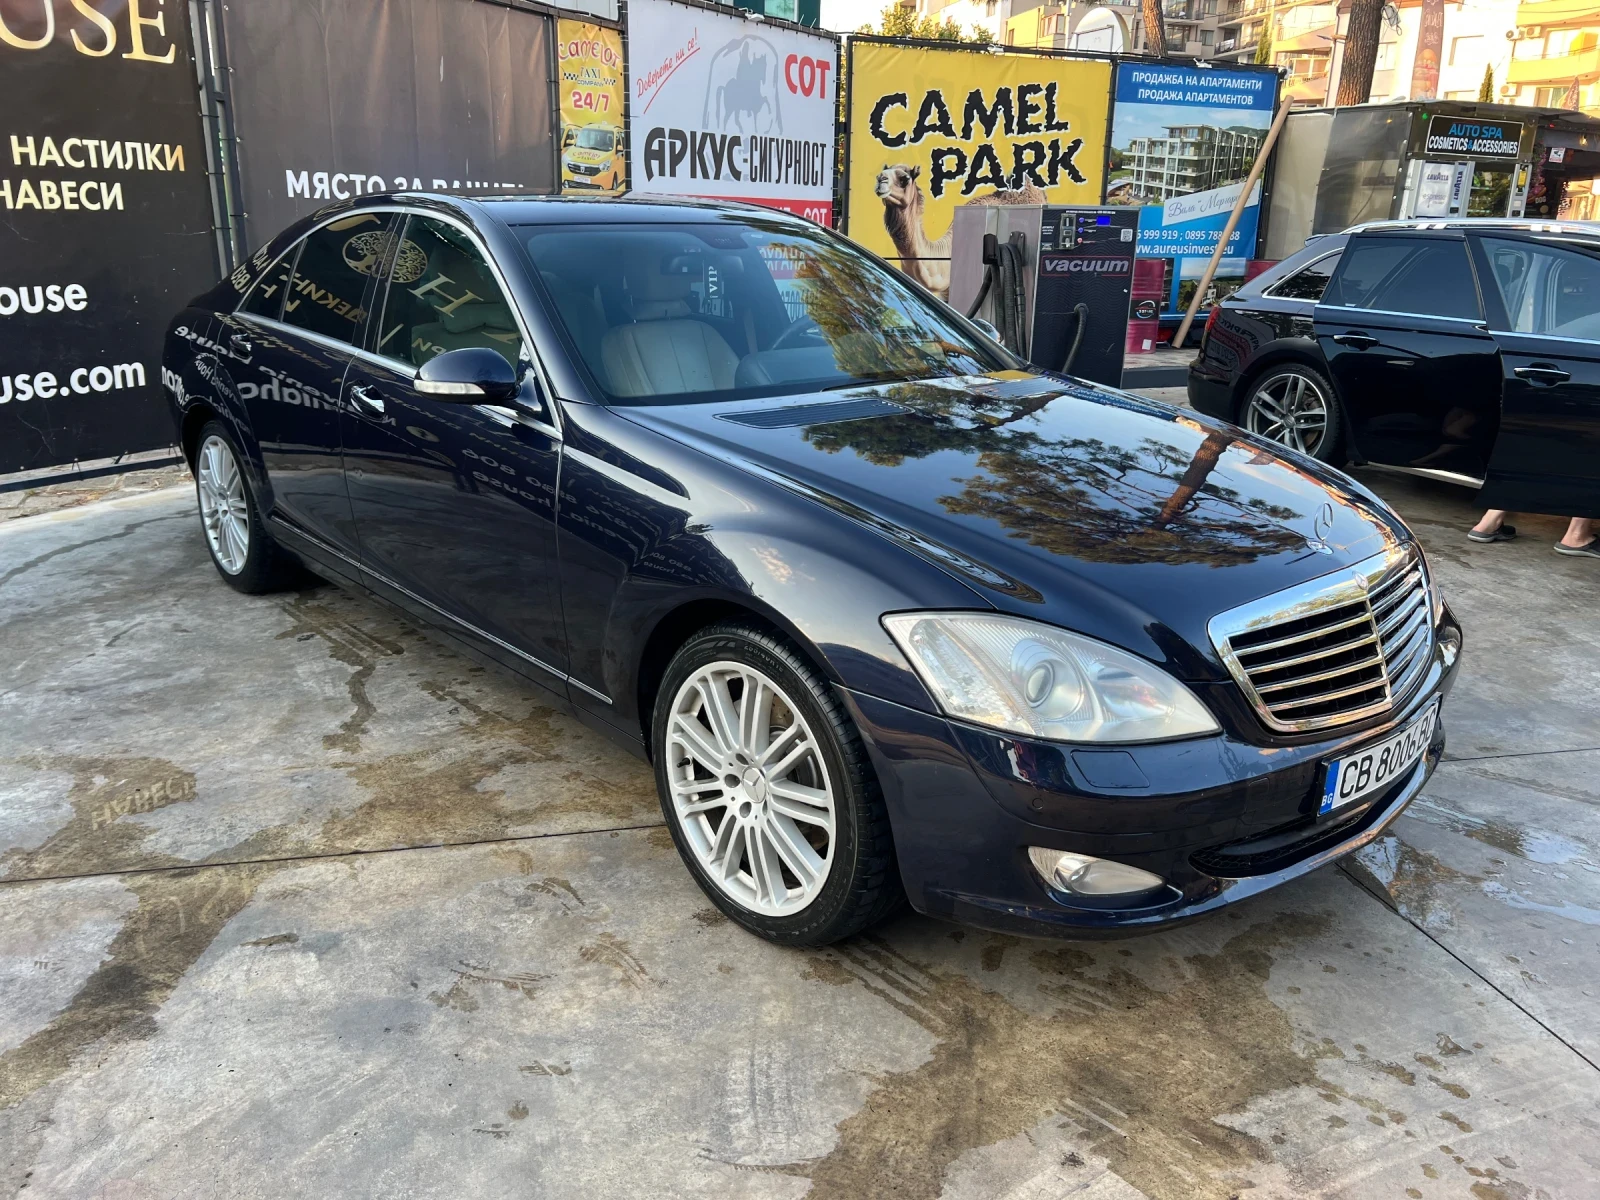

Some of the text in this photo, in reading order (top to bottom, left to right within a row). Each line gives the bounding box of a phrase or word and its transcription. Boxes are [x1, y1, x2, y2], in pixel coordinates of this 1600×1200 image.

[1132, 71, 1262, 90] ПРОДАЖБА НА АПАРТАМЕНТИ
[572, 91, 609, 113] 24/7
[1138, 89, 1253, 105] ПРОДАЖА АПАРТАМЕНТОВ
[869, 82, 1068, 148] CAMEL
[1448, 123, 1503, 139] AUTO SPA
[10, 135, 185, 172] НАСТИЛКИ
[929, 138, 1087, 198] PARK
[1143, 230, 1160, 240] 999
[1161, 230, 1178, 240] 919
[1184, 230, 1206, 241] 0895
[1044, 259, 1129, 272] vacuum
[1340, 754, 1373, 799] CB
[1375, 725, 1419, 783] 8006
[1321, 792, 1334, 807] BG
